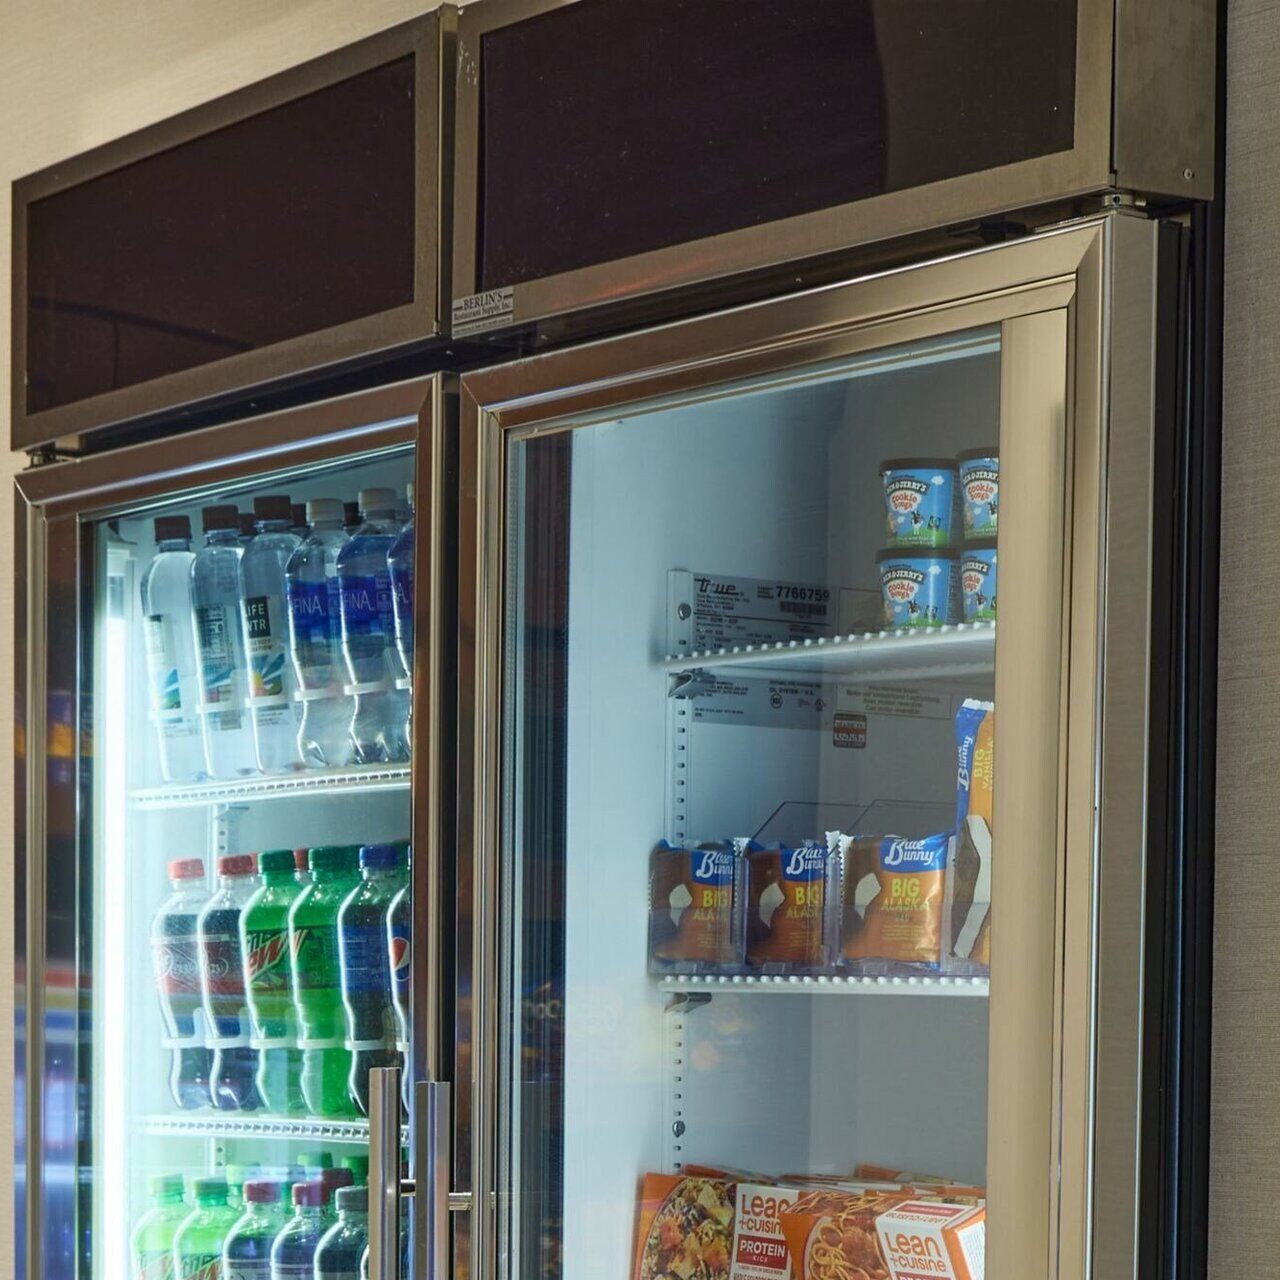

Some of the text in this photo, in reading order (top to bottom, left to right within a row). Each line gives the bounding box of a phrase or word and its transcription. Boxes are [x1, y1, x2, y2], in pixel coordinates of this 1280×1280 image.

[464, 291, 503, 311] BERLIN'S
[974, 748, 985, 779] BIG
[794, 886, 819, 906] BIG
[892, 878, 921, 897] BIG
[702, 889, 729, 908] BIG
[739, 1239, 786, 1258] PROTEIN
[884, 1231, 942, 1258] Lean
